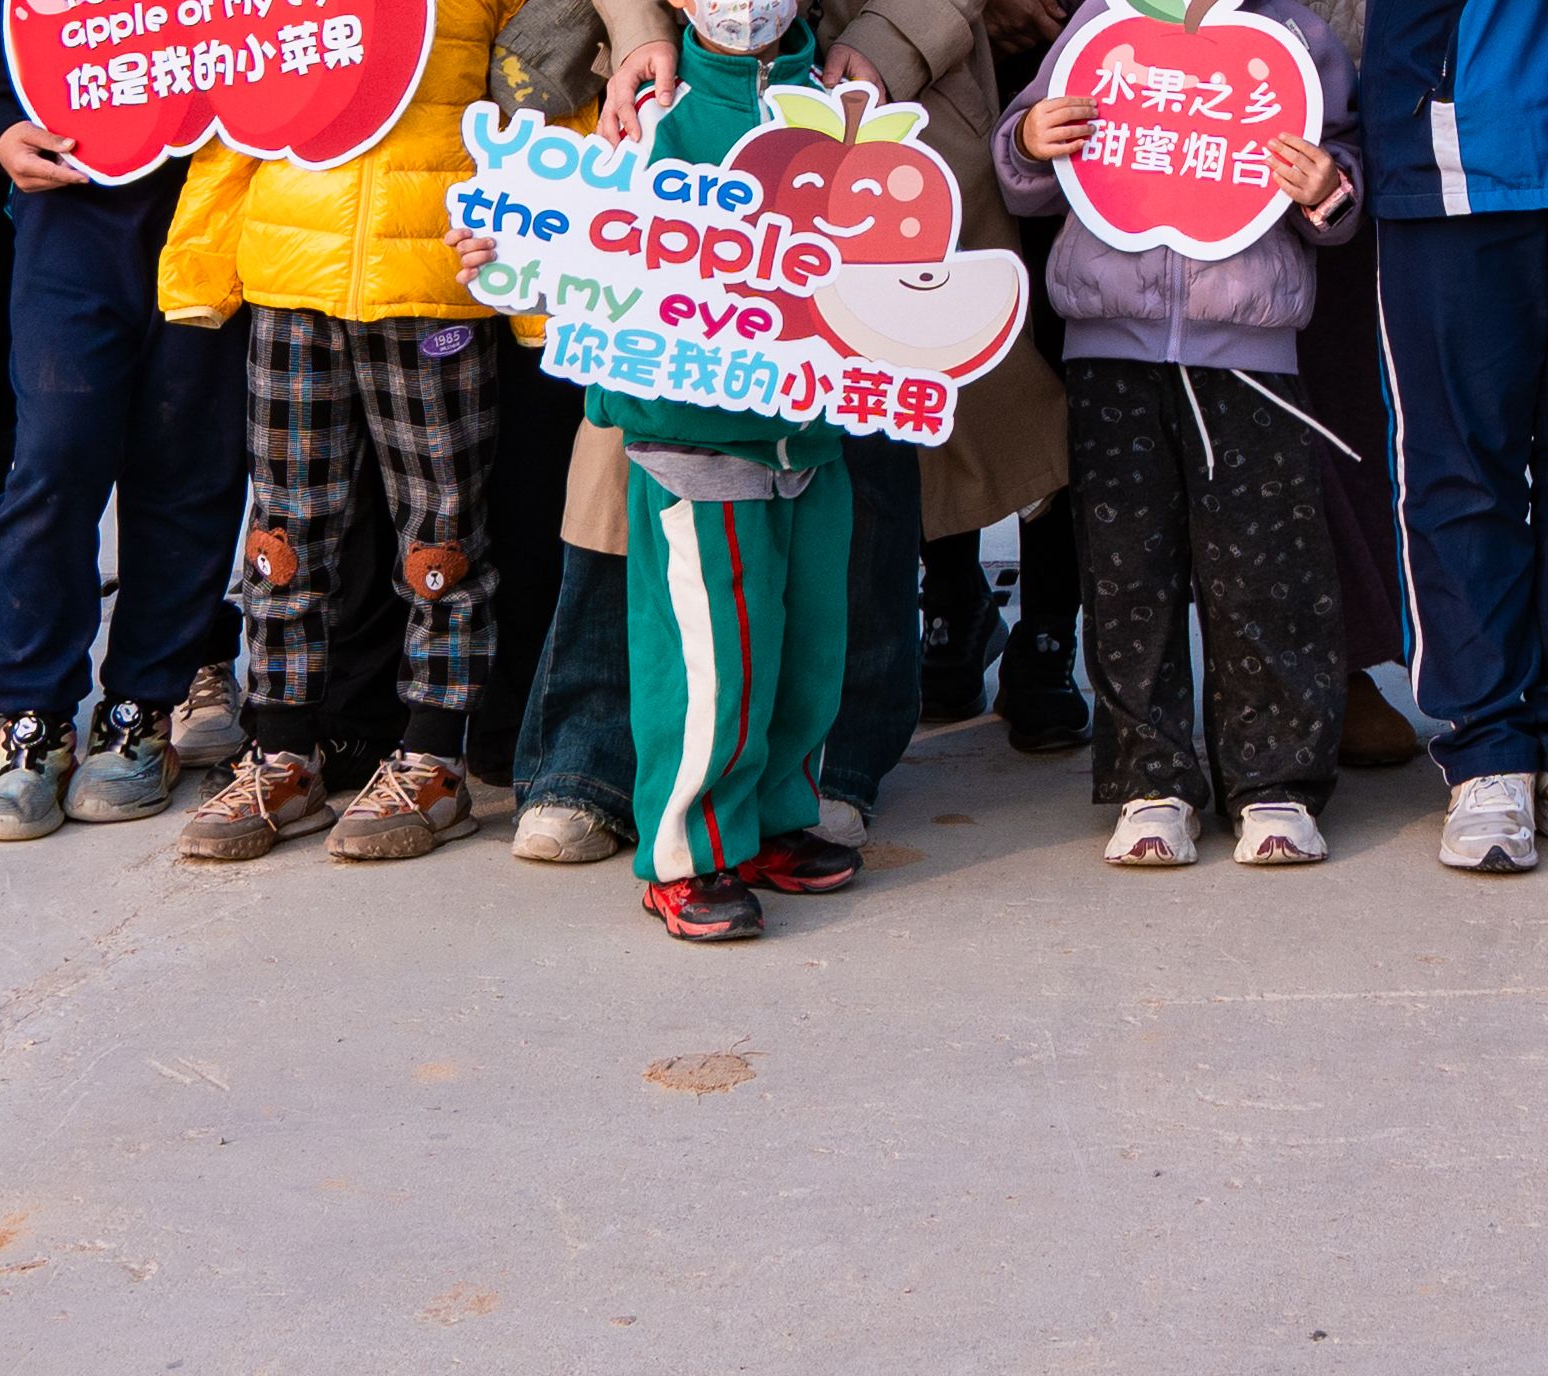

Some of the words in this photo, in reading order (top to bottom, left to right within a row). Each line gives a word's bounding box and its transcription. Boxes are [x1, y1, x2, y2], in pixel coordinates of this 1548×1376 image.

[60, 0, 169, 49] apple
[66, 15, 364, 111] 你是我的小苹果
[1091, 61, 1282, 125] 水果之乡
[1081, 119, 1272, 188] 甜蜜烟台
[652, 167, 753, 212] are
[457, 187, 570, 242] the
[589, 208, 832, 287] apple
[477, 260, 539, 299] of
[556, 271, 643, 324] my
[659, 293, 774, 340] eye
[434, 330, 460, 347] 1985
[553, 322, 948, 435] 你是我的小苹果
